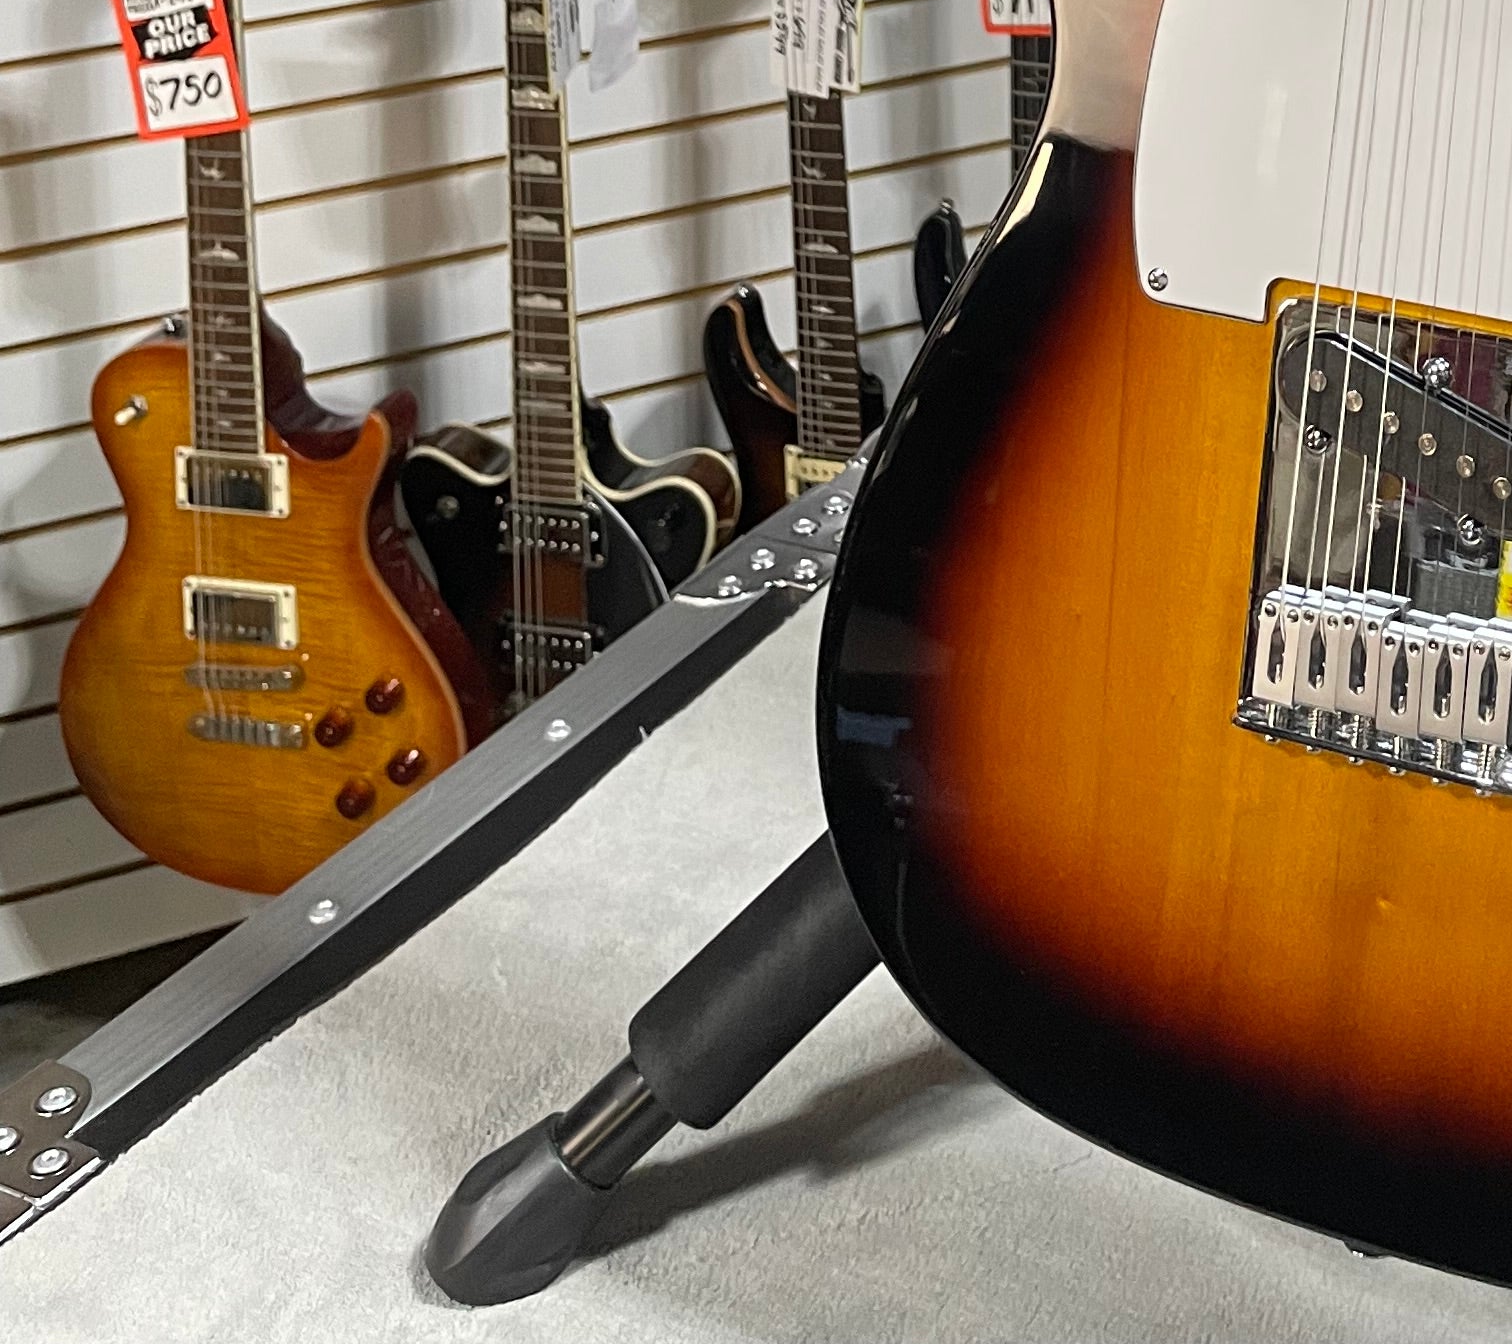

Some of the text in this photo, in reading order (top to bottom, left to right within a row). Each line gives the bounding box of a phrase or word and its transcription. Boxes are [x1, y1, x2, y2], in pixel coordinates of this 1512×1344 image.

[143, 22, 212, 60] PRICE
[147, 10, 196, 38] OUR
[145, 70, 222, 118] $750
